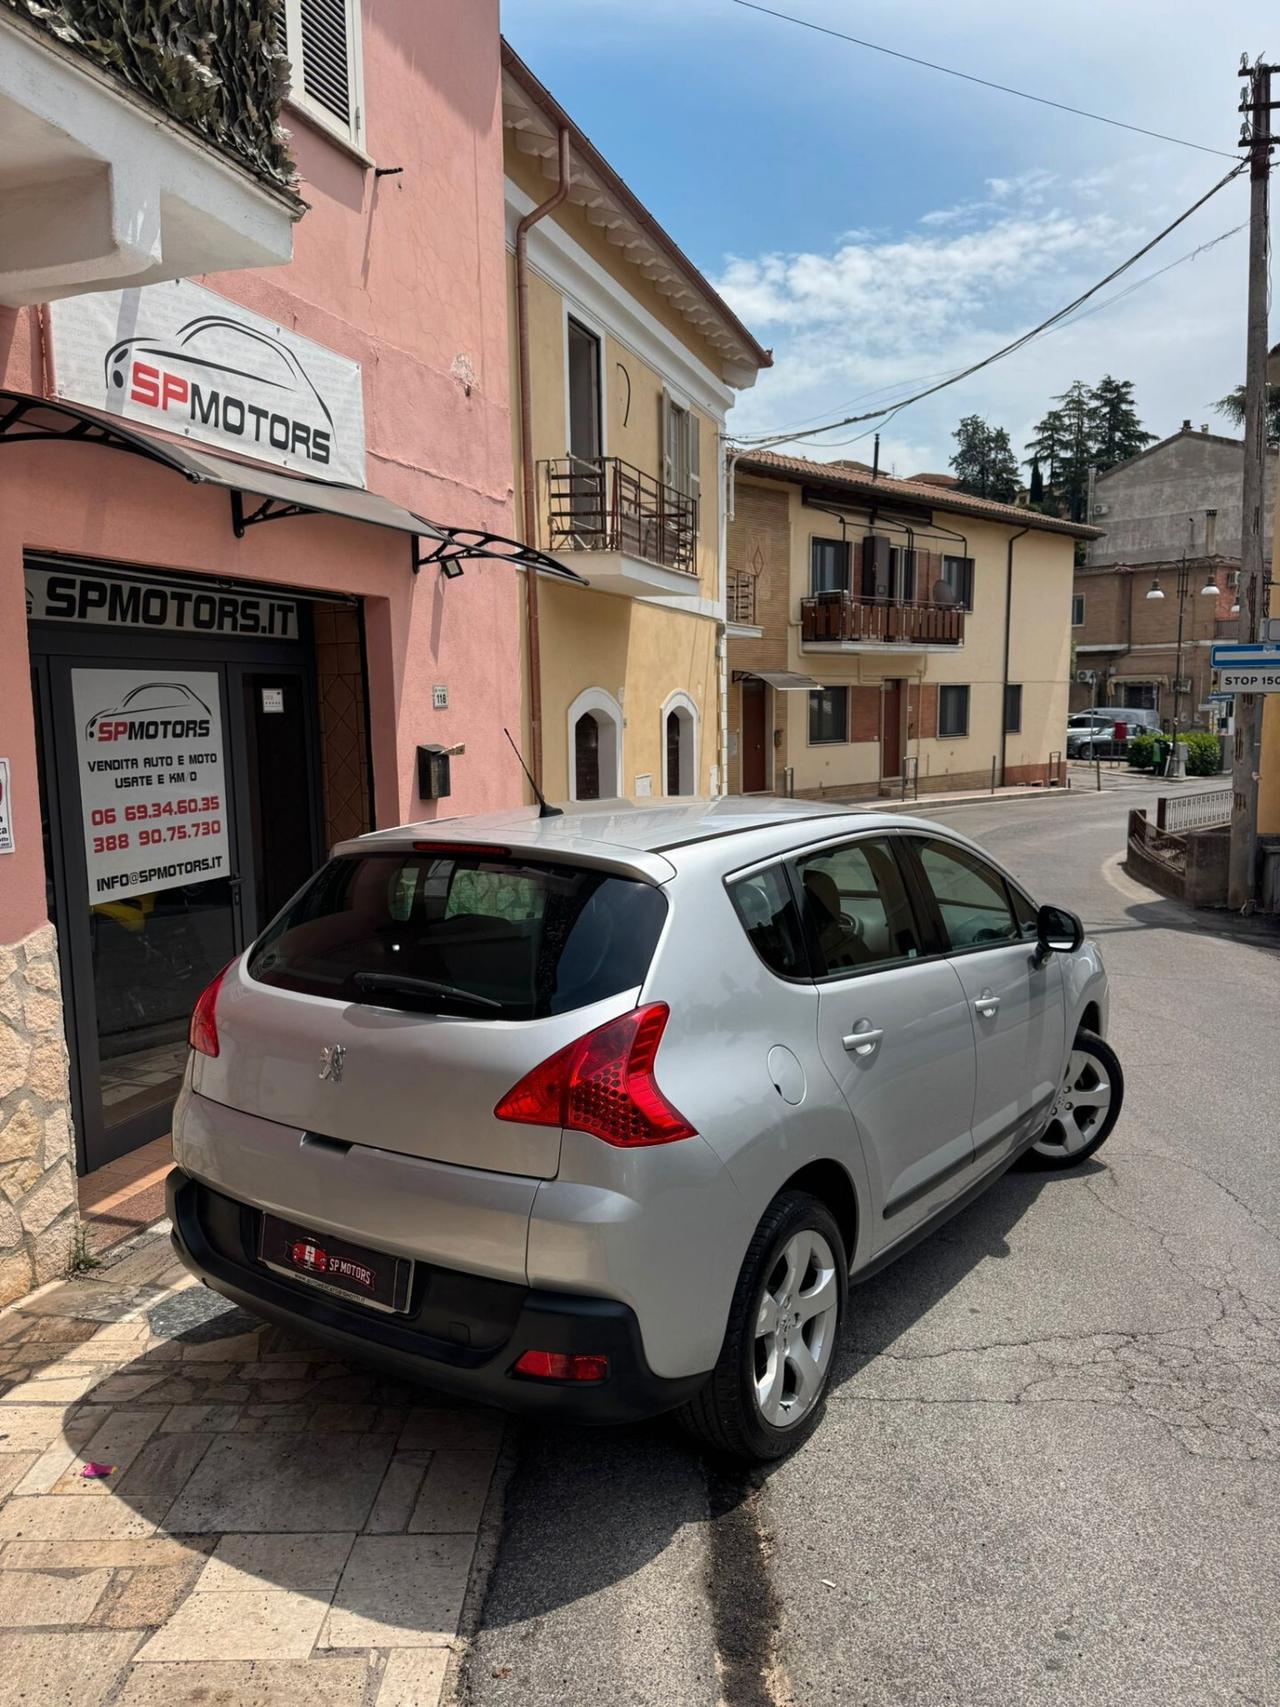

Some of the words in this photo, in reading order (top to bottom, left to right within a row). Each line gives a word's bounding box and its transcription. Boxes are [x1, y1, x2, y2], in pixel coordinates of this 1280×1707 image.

[131, 361, 330, 465] SPMOTORS
[45, 576, 294, 635] SPMOTORS.IT
[1225, 676, 1258, 685] STOP
[98, 719, 210, 742] SPMOTORS
[88, 757, 139, 772] VENDITA
[143, 755, 173, 768] AUTO
[178, 755, 185, 765] E
[189, 753, 217, 765] MOTO
[115, 775, 153, 788] USATE
[158, 774, 164, 784] E
[169, 772, 185, 783] KM
[91, 807, 117, 826] 06
[124, 796, 220, 821] 69.34.60.35
[93, 833, 130, 853] 388
[138, 820, 221, 846] 90.75.730
[96, 856, 223, 891] INFO@SPMOTORS.IT
[329, 1258, 340, 1272] SP
[340, 1260, 371, 1285] MOTORS
